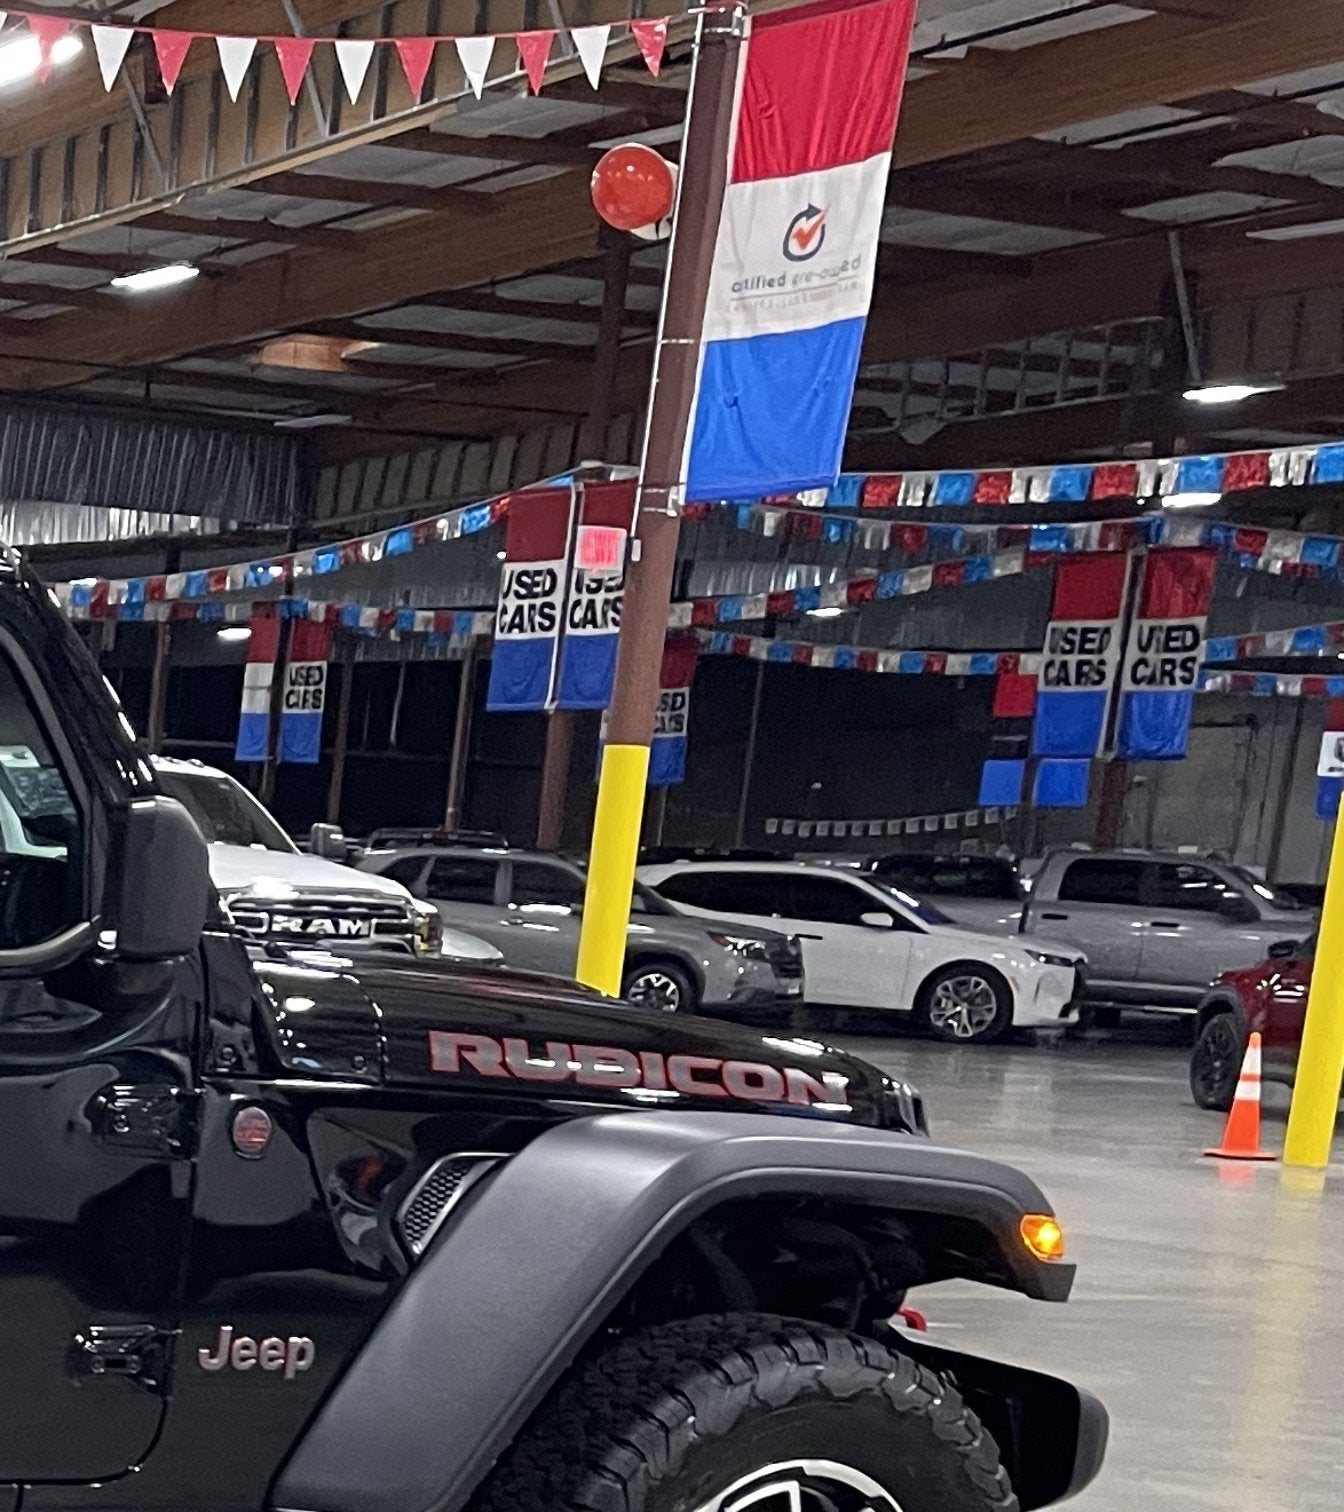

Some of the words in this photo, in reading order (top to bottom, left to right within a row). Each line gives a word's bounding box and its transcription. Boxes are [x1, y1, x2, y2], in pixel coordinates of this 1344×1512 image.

[1138, 624, 1201, 654] UED
[272, 914, 370, 935] RAM
[427, 1029, 850, 1105] RUBICON
[198, 1325, 315, 1380] Jeep
